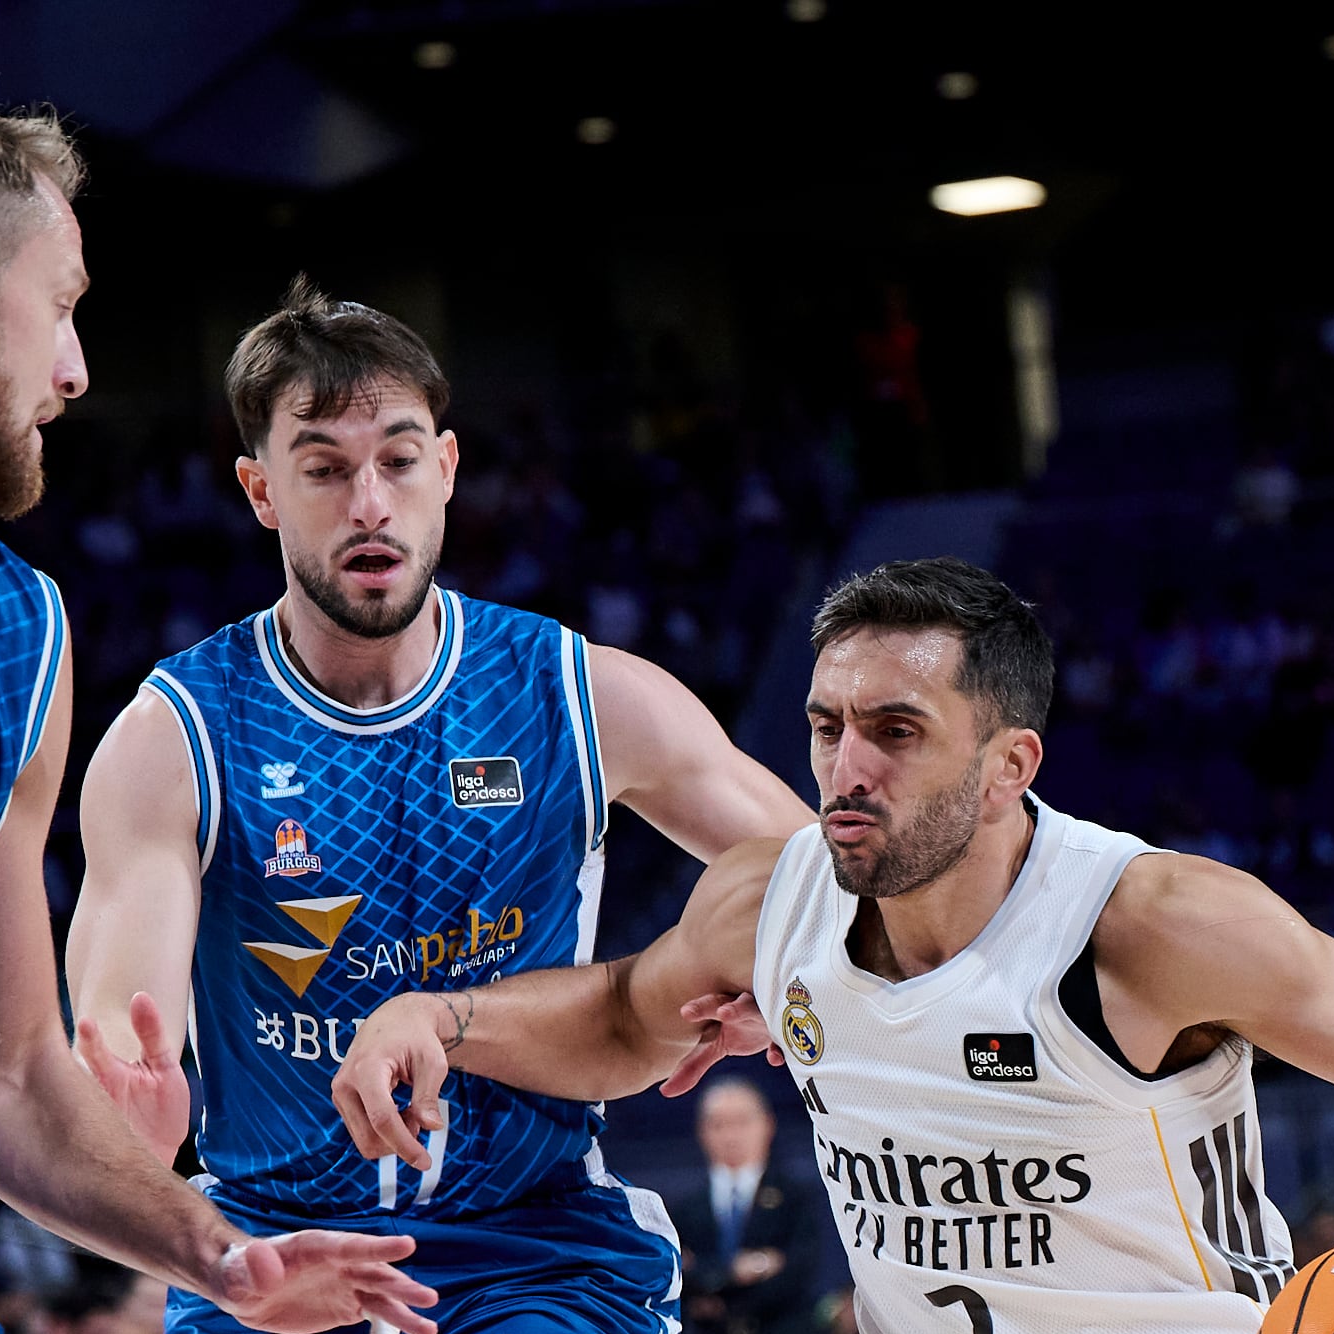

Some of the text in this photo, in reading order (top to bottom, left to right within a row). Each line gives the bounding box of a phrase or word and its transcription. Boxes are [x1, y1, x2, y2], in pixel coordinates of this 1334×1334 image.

[456, 773, 484, 789] liga
[459, 786, 518, 801] endesa
[268, 857, 318, 873] BURGOS
[969, 1048, 998, 1065] liga
[973, 1063, 1034, 1077] endesa
[904, 1212, 1055, 1271] BETTER
